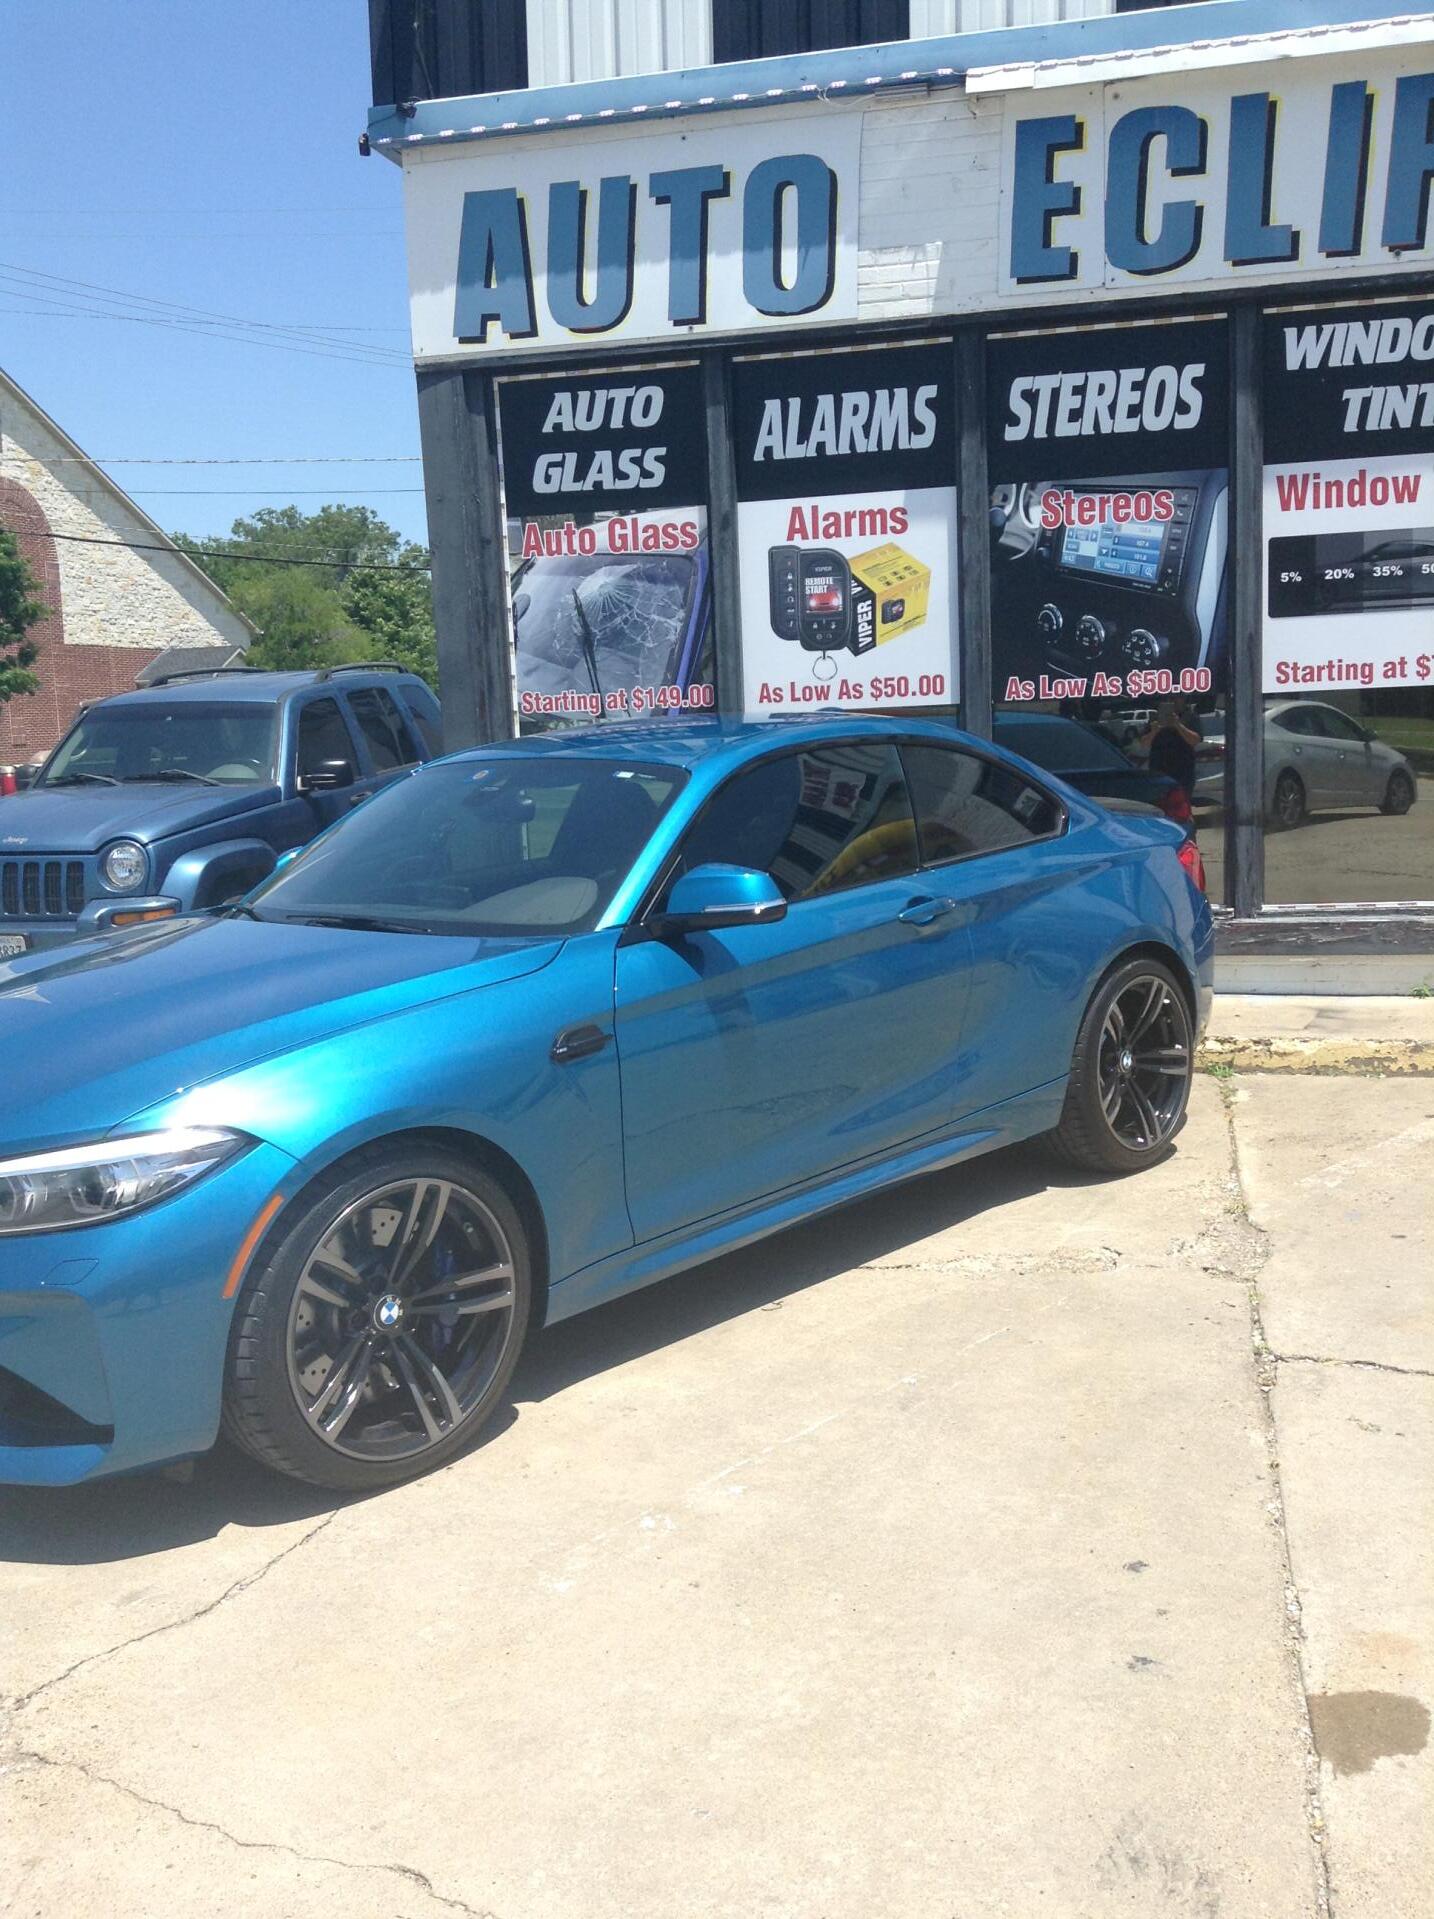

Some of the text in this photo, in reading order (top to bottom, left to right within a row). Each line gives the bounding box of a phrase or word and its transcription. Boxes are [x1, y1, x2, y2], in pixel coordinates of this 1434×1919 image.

[453, 154, 838, 344] AUTO
[542, 385, 664, 433] AUTO
[753, 384, 938, 461] ALARMS
[1004, 363, 1206, 441] STEREOS
[532, 447, 667, 494] GLASS
[1275, 470, 1421, 512] Window
[786, 504, 909, 542] Alarms
[1040, 489, 1175, 529] Stereos
[522, 517, 700, 558] Auto Glass
[1280, 572, 1302, 583] 5%
[1324, 568, 1355, 581] 20%
[1372, 565, 1403, 577] 35%
[857, 599, 872, 648] VIPER
[758, 674, 945, 704] As Low As $50.00
[1005, 667, 1211, 701] As Low As $50.00
[1275, 659, 1374, 685] Starting
[1383, 656, 1408, 679] at
[522, 684, 715, 715] Starting at $149.00
